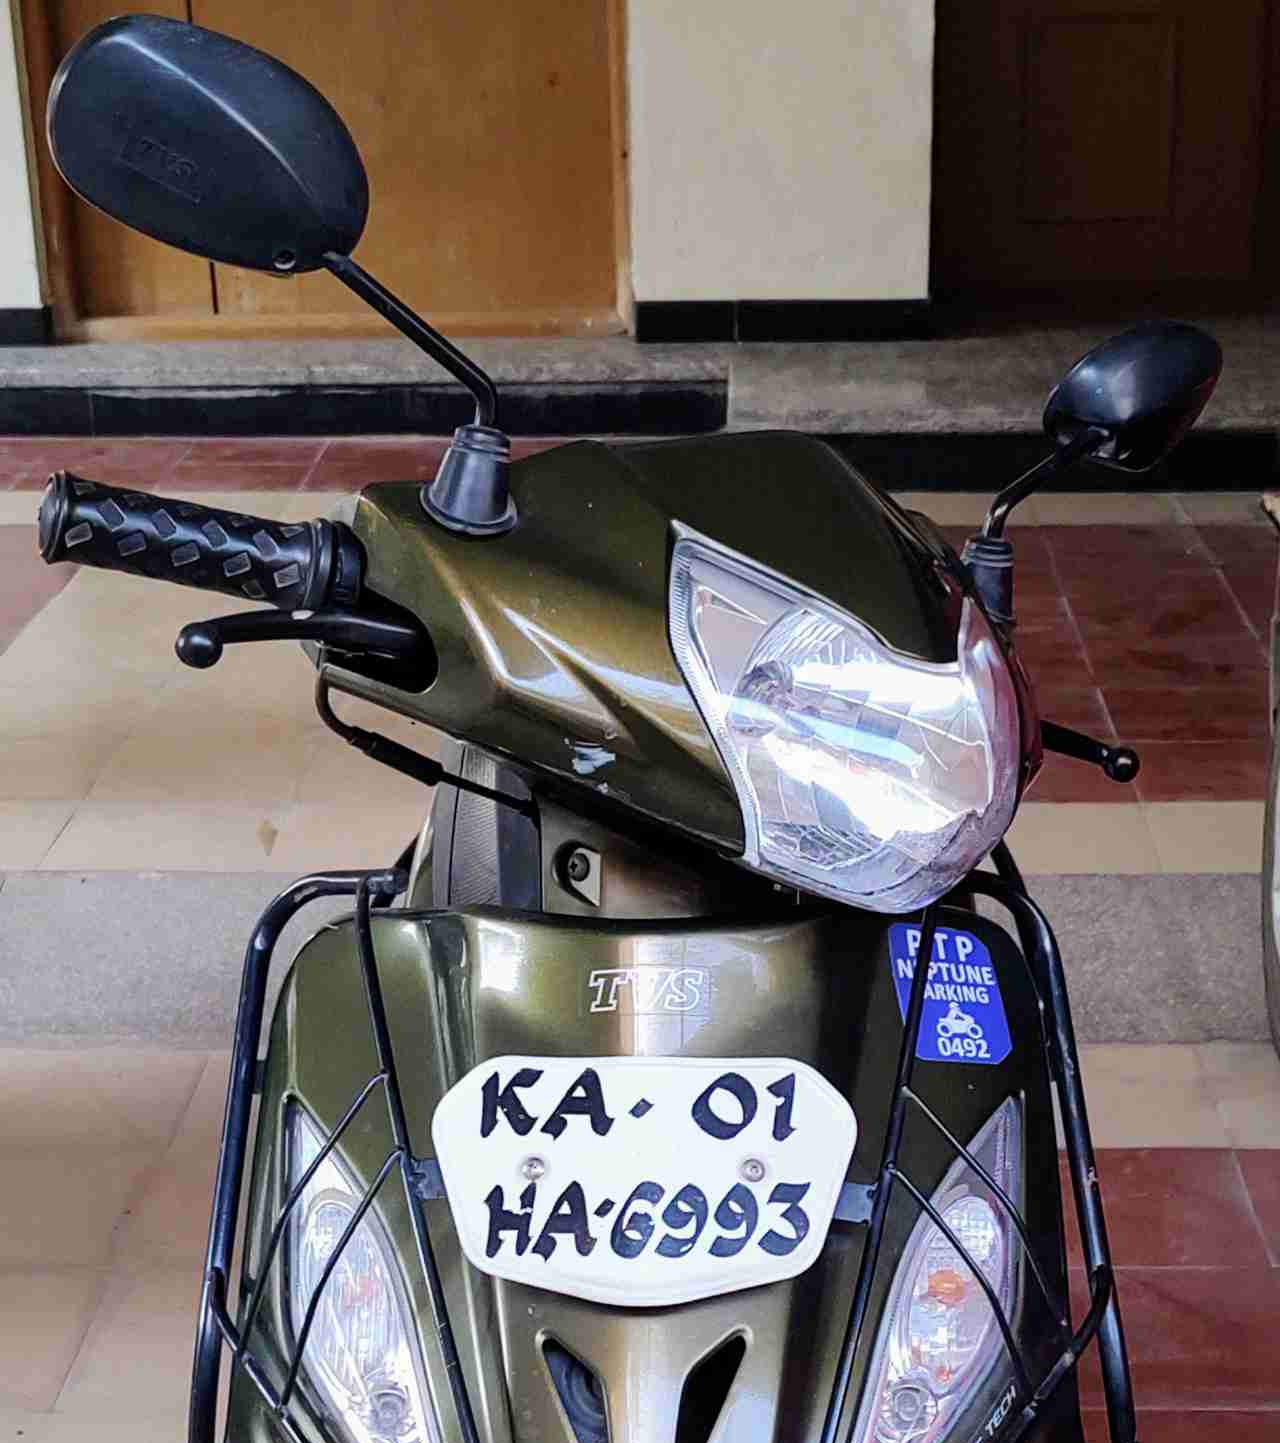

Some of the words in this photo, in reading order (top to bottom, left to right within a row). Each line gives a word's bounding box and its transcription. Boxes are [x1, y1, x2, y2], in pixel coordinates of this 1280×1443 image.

[896, 958, 996, 985] NPTUNE
[589, 968, 704, 1013] TVS
[923, 983, 990, 1004] ARKING
[937, 1037, 992, 1059] 0492
[691, 1072, 797, 1141] 01
[985, 1385, 1017, 1436] TECH
